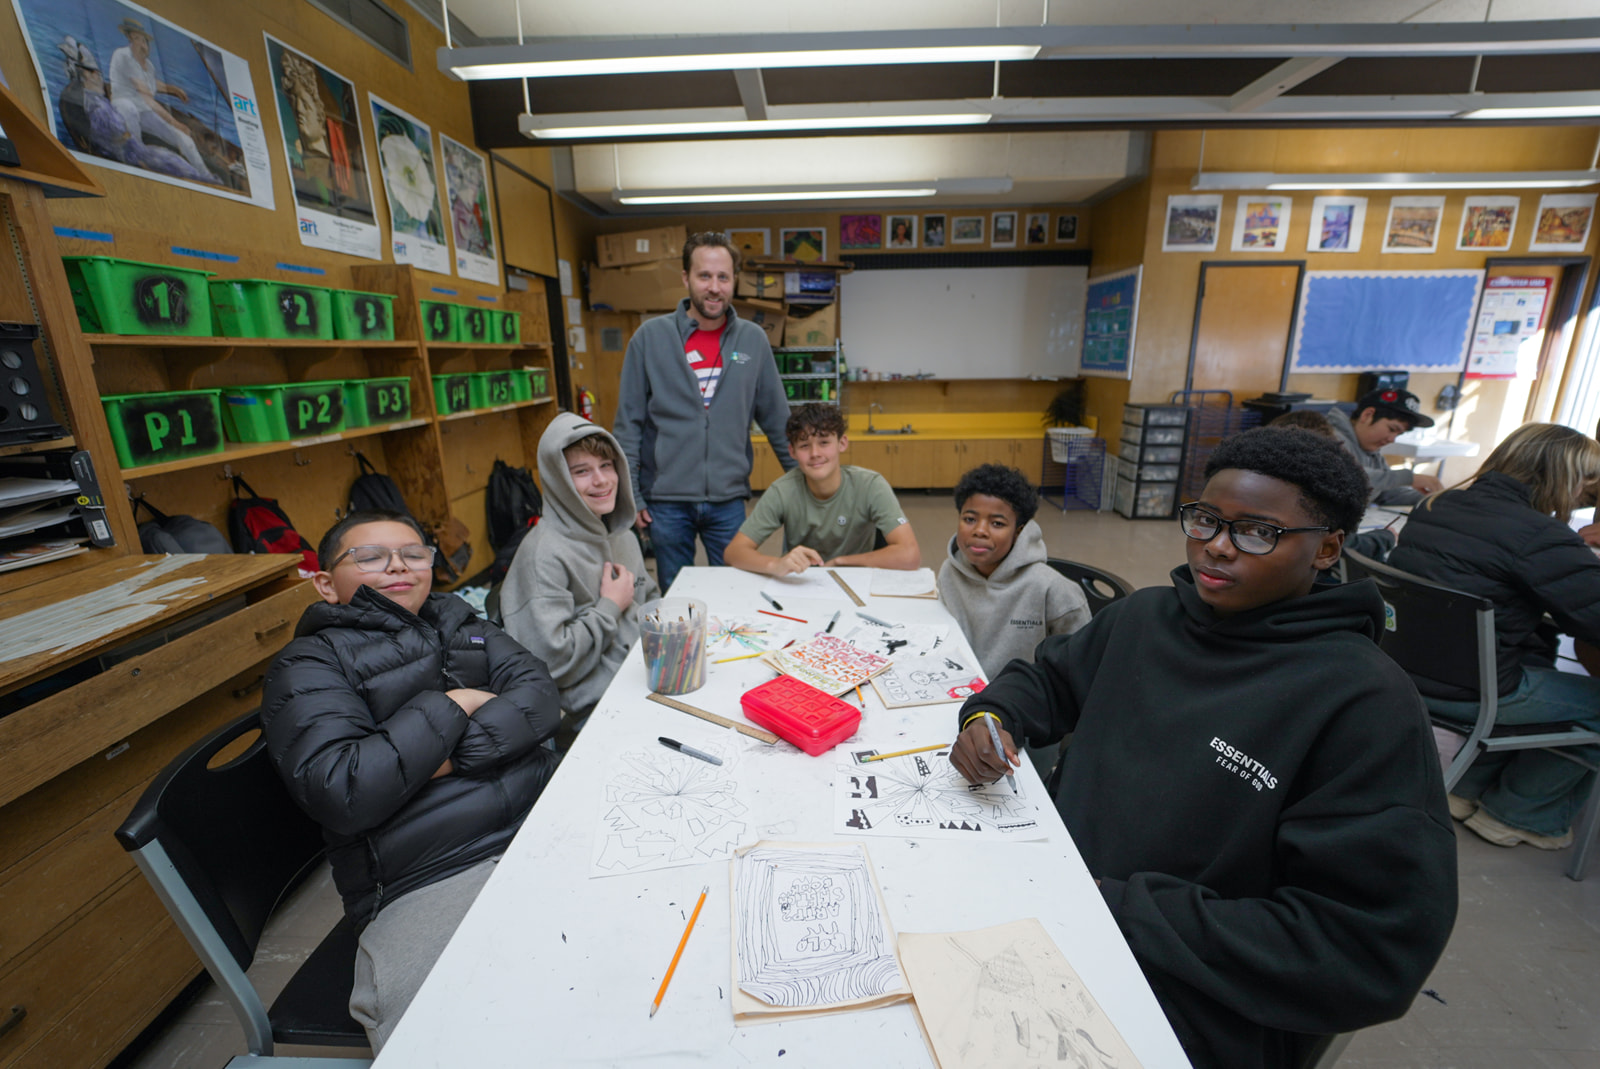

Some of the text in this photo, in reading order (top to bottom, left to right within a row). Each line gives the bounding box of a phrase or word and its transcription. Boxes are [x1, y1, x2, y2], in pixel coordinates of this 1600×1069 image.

[233, 96, 257, 116] art
[300, 221, 319, 236] art
[152, 281, 170, 319] 1
[293, 294, 310, 325] 2
[365, 302, 377, 329] 3
[434, 310, 444, 333] 4
[1209, 736, 1278, 789] ESSENTIALS
[1215, 756, 1239, 773] FEAR
[1239, 770, 1252, 780] OF
